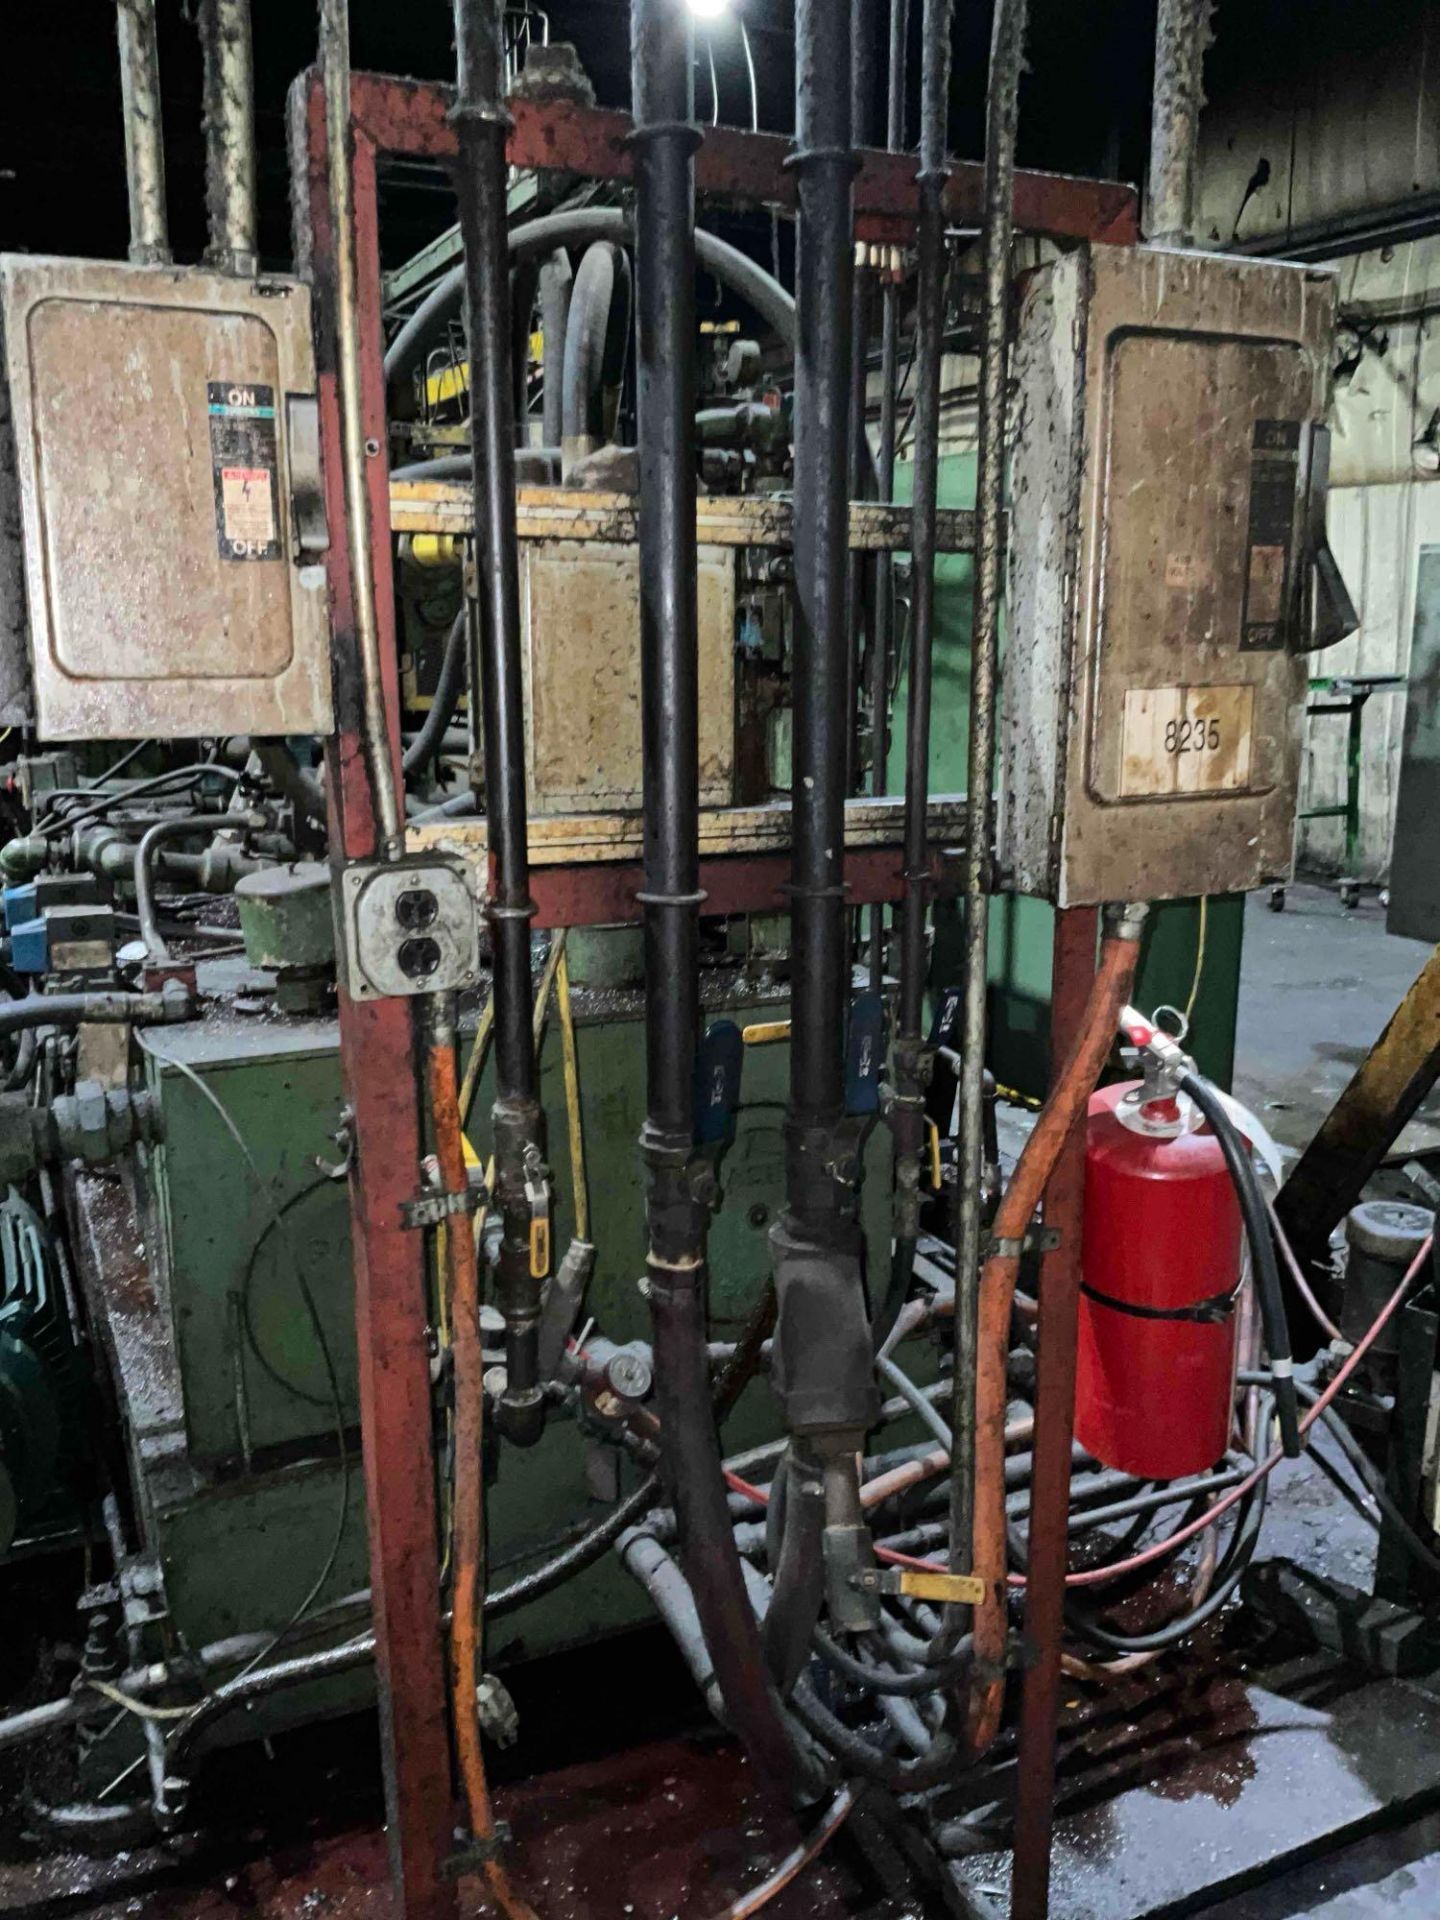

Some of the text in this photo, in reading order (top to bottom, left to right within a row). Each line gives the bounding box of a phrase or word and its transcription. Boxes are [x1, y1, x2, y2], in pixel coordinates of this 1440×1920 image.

[228, 388, 256, 406] ON
[1265, 430, 1287, 446] ON
[233, 540, 268, 555] OFF
[1247, 627, 1276, 643] OFF
[1164, 718, 1222, 753] 8235
